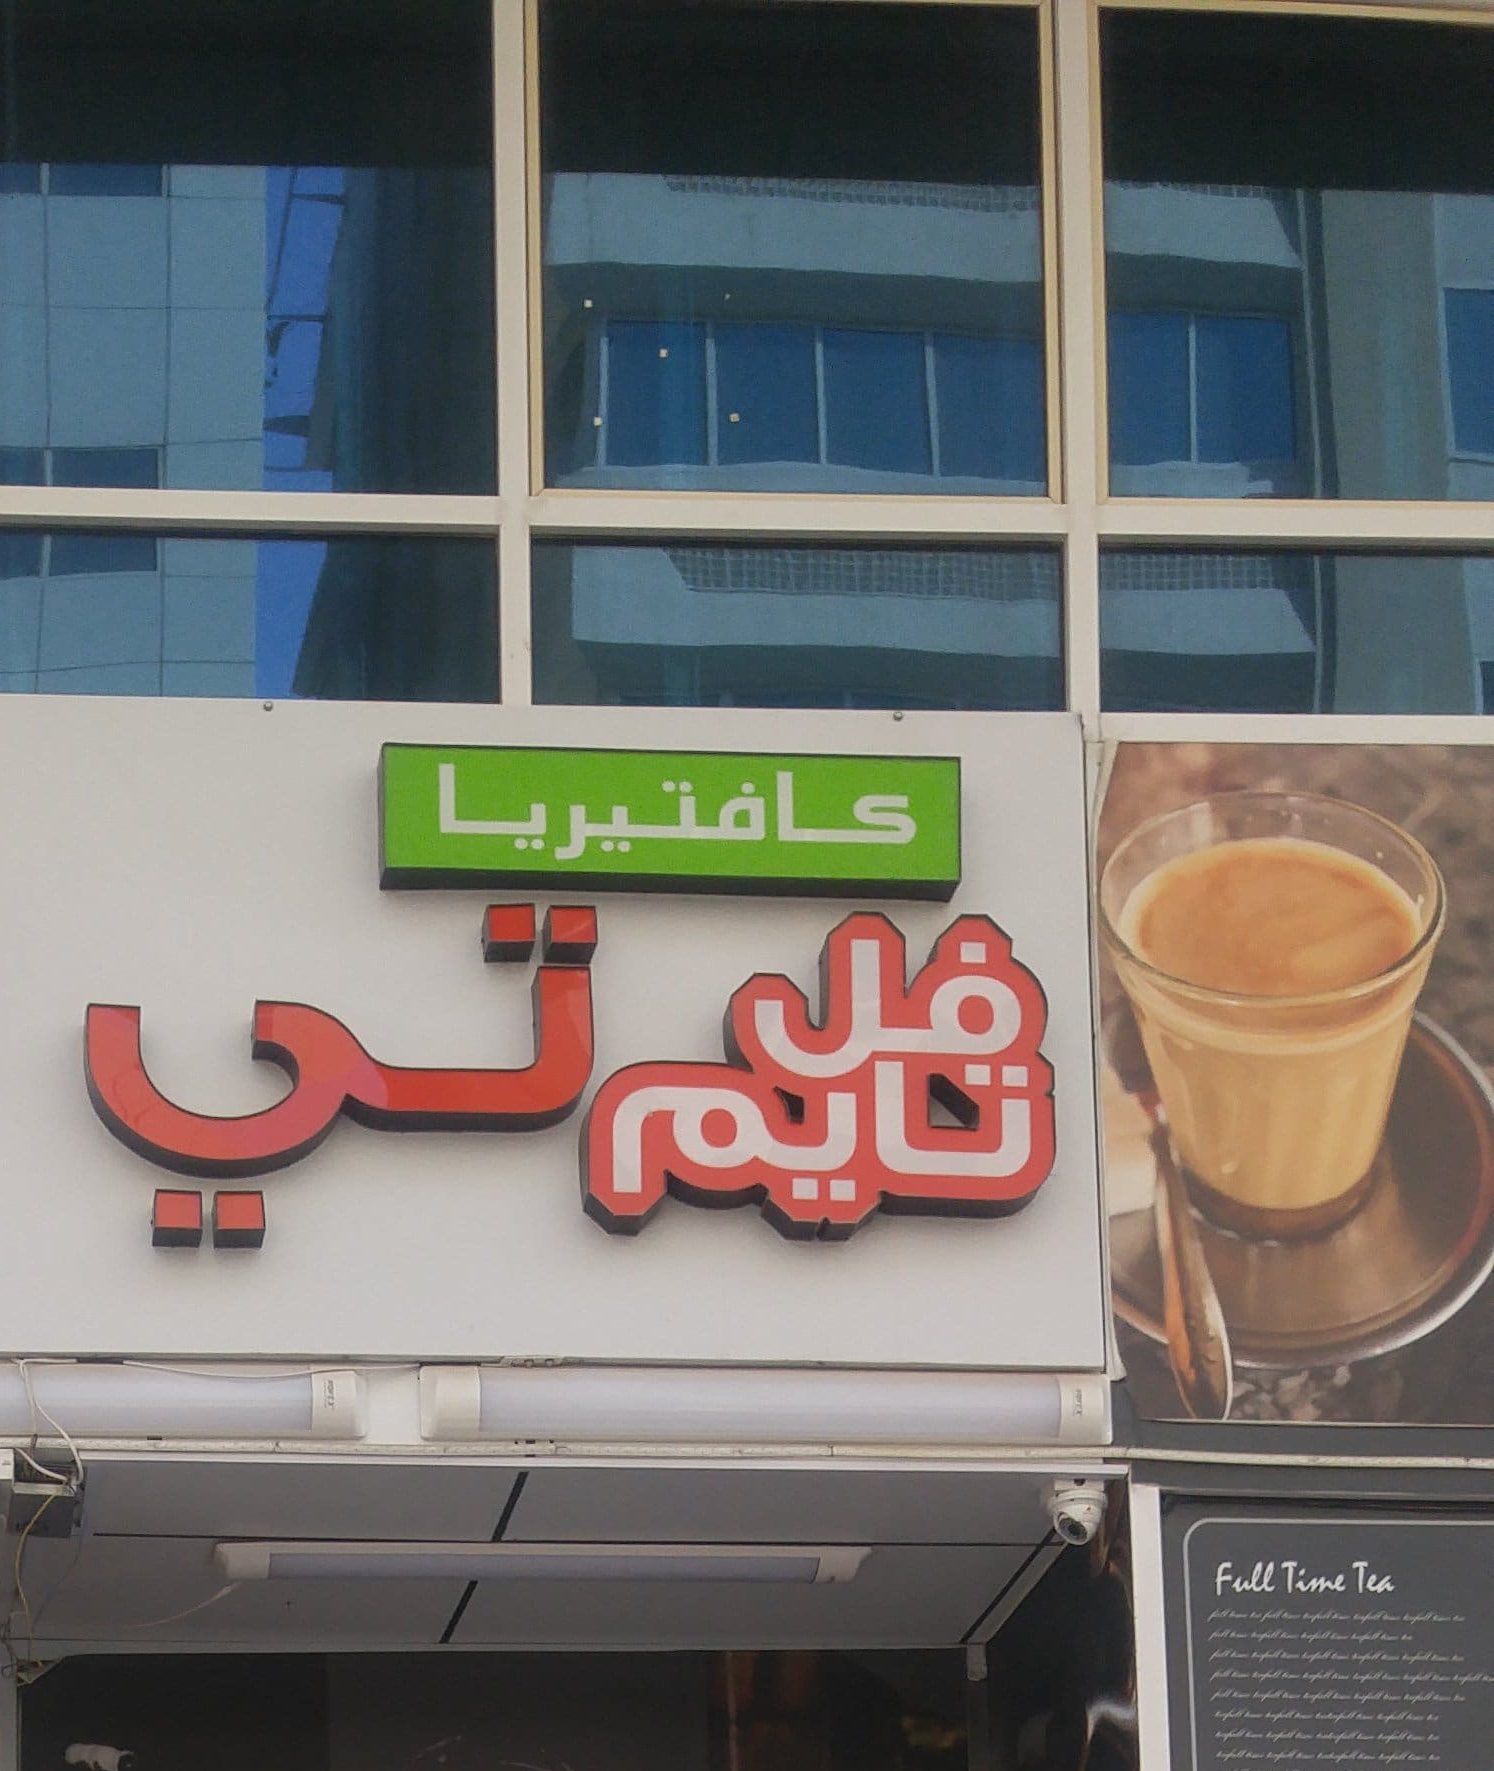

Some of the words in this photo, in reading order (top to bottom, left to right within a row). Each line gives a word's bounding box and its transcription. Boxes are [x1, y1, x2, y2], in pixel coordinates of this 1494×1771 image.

[436, 761, 918, 860] كافتيريا
[85, 903, 599, 1248] تي
[752, 934, 1024, 1079] فل
[609, 1058, 1030, 1204] تايم
[1215, 1561, 1275, 1596] Full
[1281, 1560, 1346, 1594] Time
[1352, 1560, 1395, 1594] Tea
